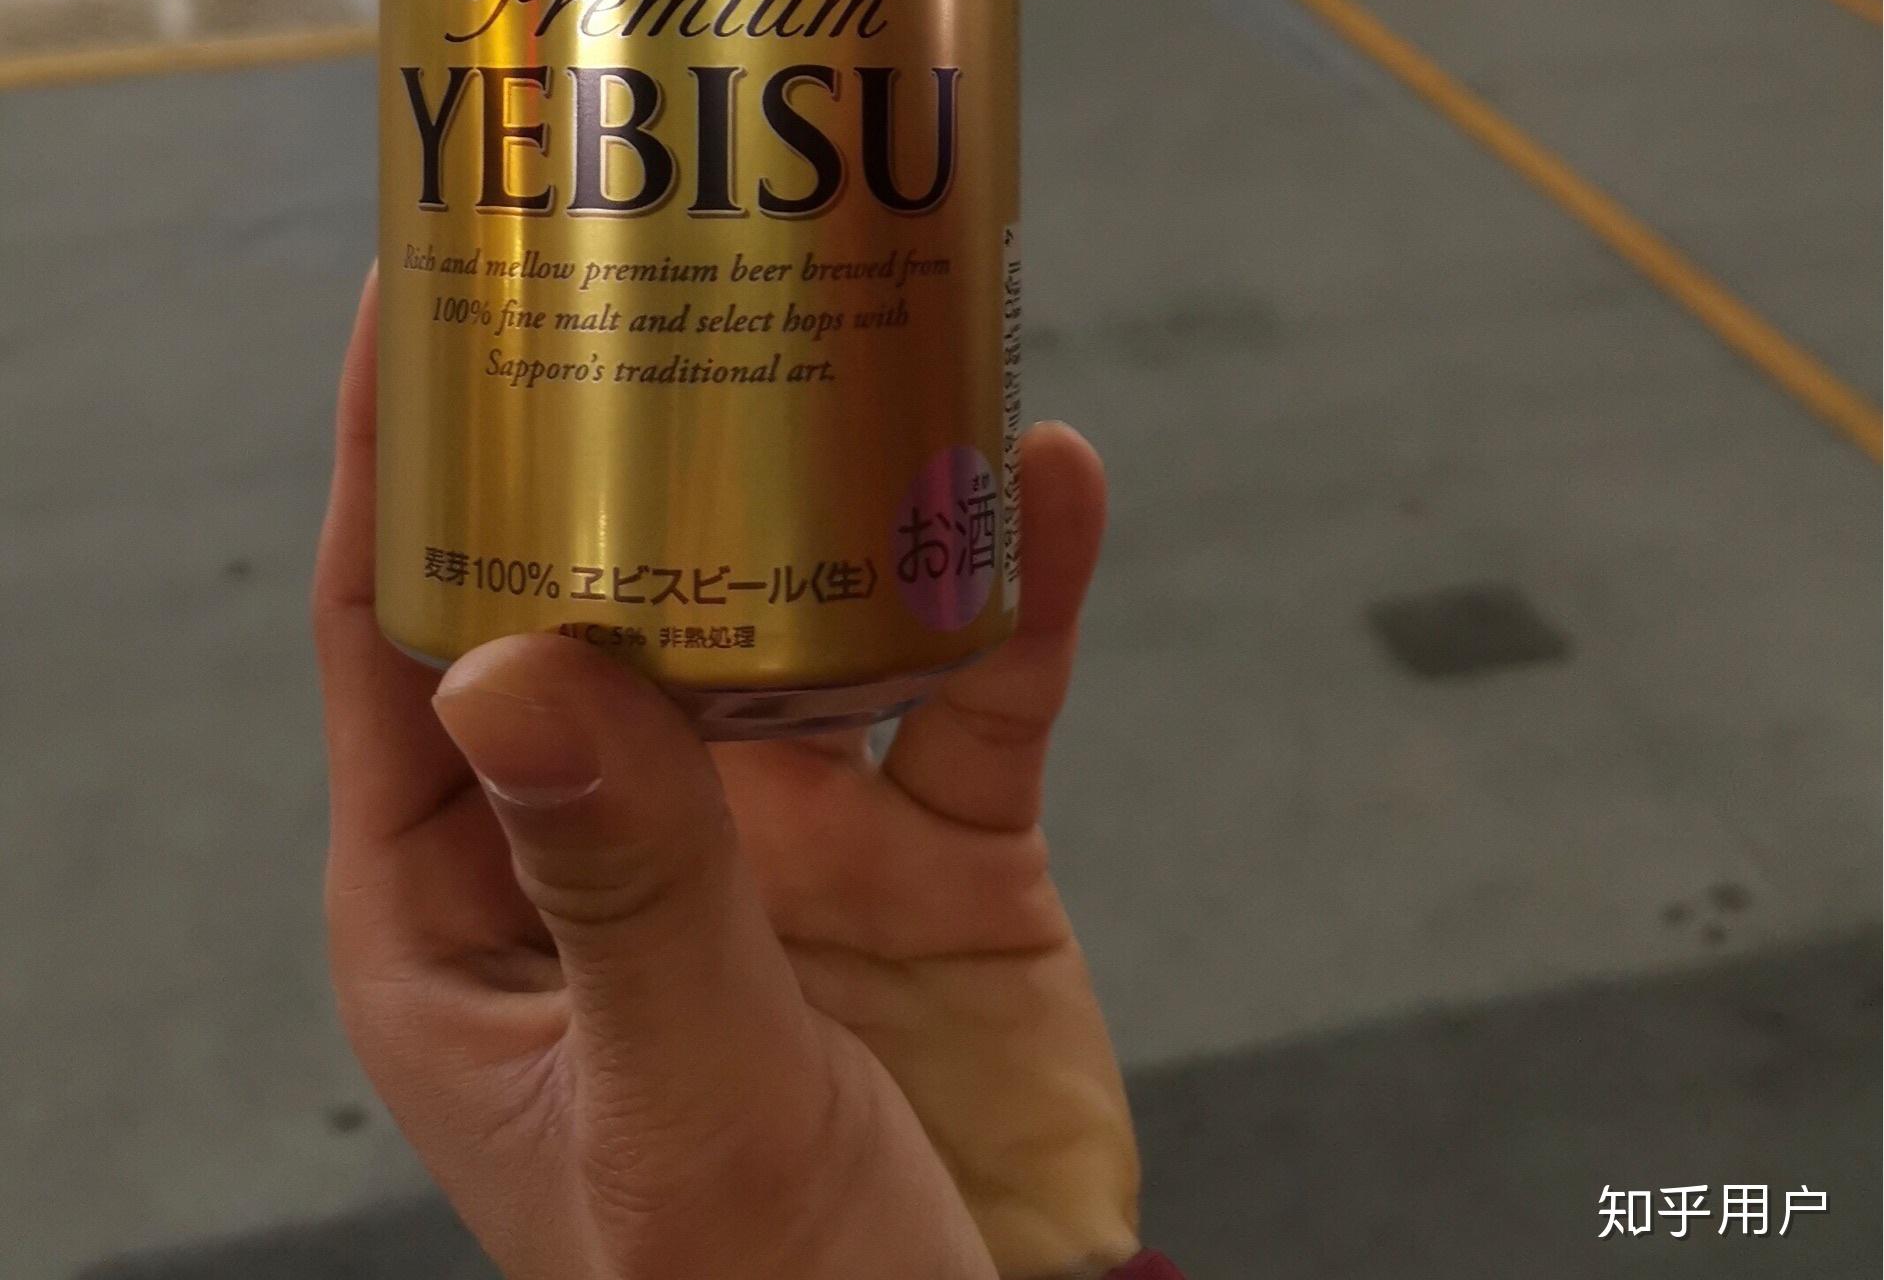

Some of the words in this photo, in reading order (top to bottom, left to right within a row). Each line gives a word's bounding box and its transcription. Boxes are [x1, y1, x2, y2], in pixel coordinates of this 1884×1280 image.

[400, 65, 962, 220] YEBISU
[403, 243, 436, 271] Rich
[439, 248, 481, 276] and
[485, 250, 576, 280] mellow
[579, 256, 719, 291] premium
[730, 253, 793, 283] beer
[801, 249, 897, 283] brewed
[895, 249, 951, 288] from
[432, 296, 492, 326] 100%
[493, 298, 546, 337] fine
[554, 303, 623, 333] malt
[627, 303, 692, 334] and
[695, 303, 775, 334] select
[781, 302, 845, 342] hops
[852, 297, 909, 328] with
[486, 348, 606, 388] Sapporo's
[613, 352, 781, 385] traditional
[785, 361, 836, 383] art.
[897, 493, 996, 584] お酒
[424, 546, 560, 600] 麦芽100%
[658, 625, 756, 649] 非熱処理
